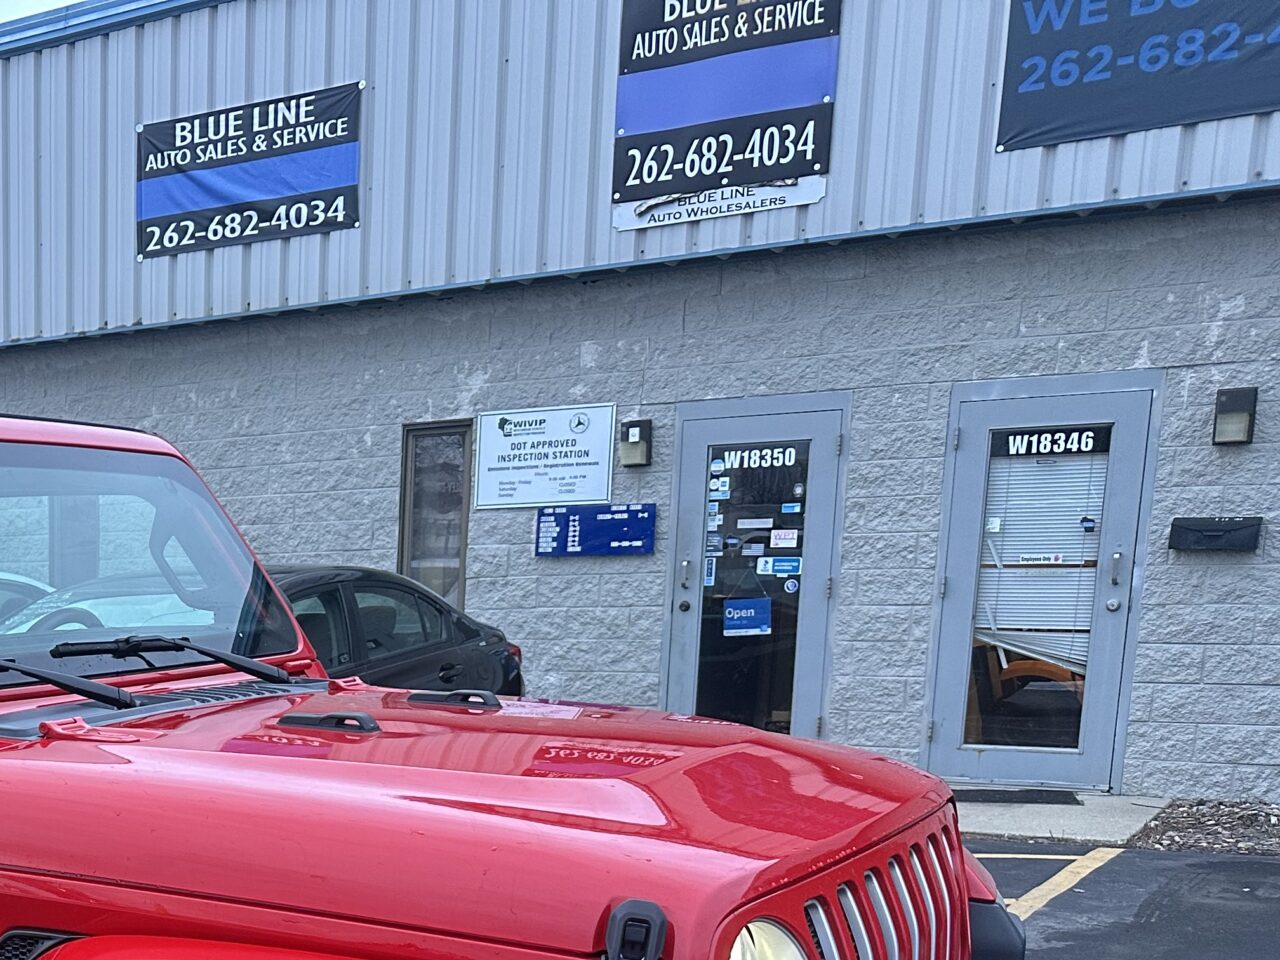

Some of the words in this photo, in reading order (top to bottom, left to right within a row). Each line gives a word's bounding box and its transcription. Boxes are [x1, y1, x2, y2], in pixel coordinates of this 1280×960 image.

[632, 28, 678, 60] AUTO
[682, 15, 730, 50] SALES
[734, 11, 748, 39] &
[752, 0, 825, 35] SERVICE
[175, 110, 244, 147] BLUE
[252, 95, 316, 132] LINE
[145, 148, 191, 172] AUTO
[195, 137, 248, 163] SALES
[252, 133, 268, 152] &
[272, 117, 349, 149] SERVICE
[625, 120, 815, 187] 262-682-4034
[677, 191, 718, 207] BLUE
[720, 186, 756, 201] LINE
[145, 196, 346, 252] 262-682-4034
[513, 418, 547, 428] WIVIP
[510, 442, 527, 451] DOT
[530, 438, 577, 450] APPROVED
[1008, 430, 1094, 455] W18346
[497, 451, 549, 463] INSPECTION
[551, 449, 590, 460] STATION
[723, 447, 796, 469] W18350
[725, 608, 755, 619] Open
